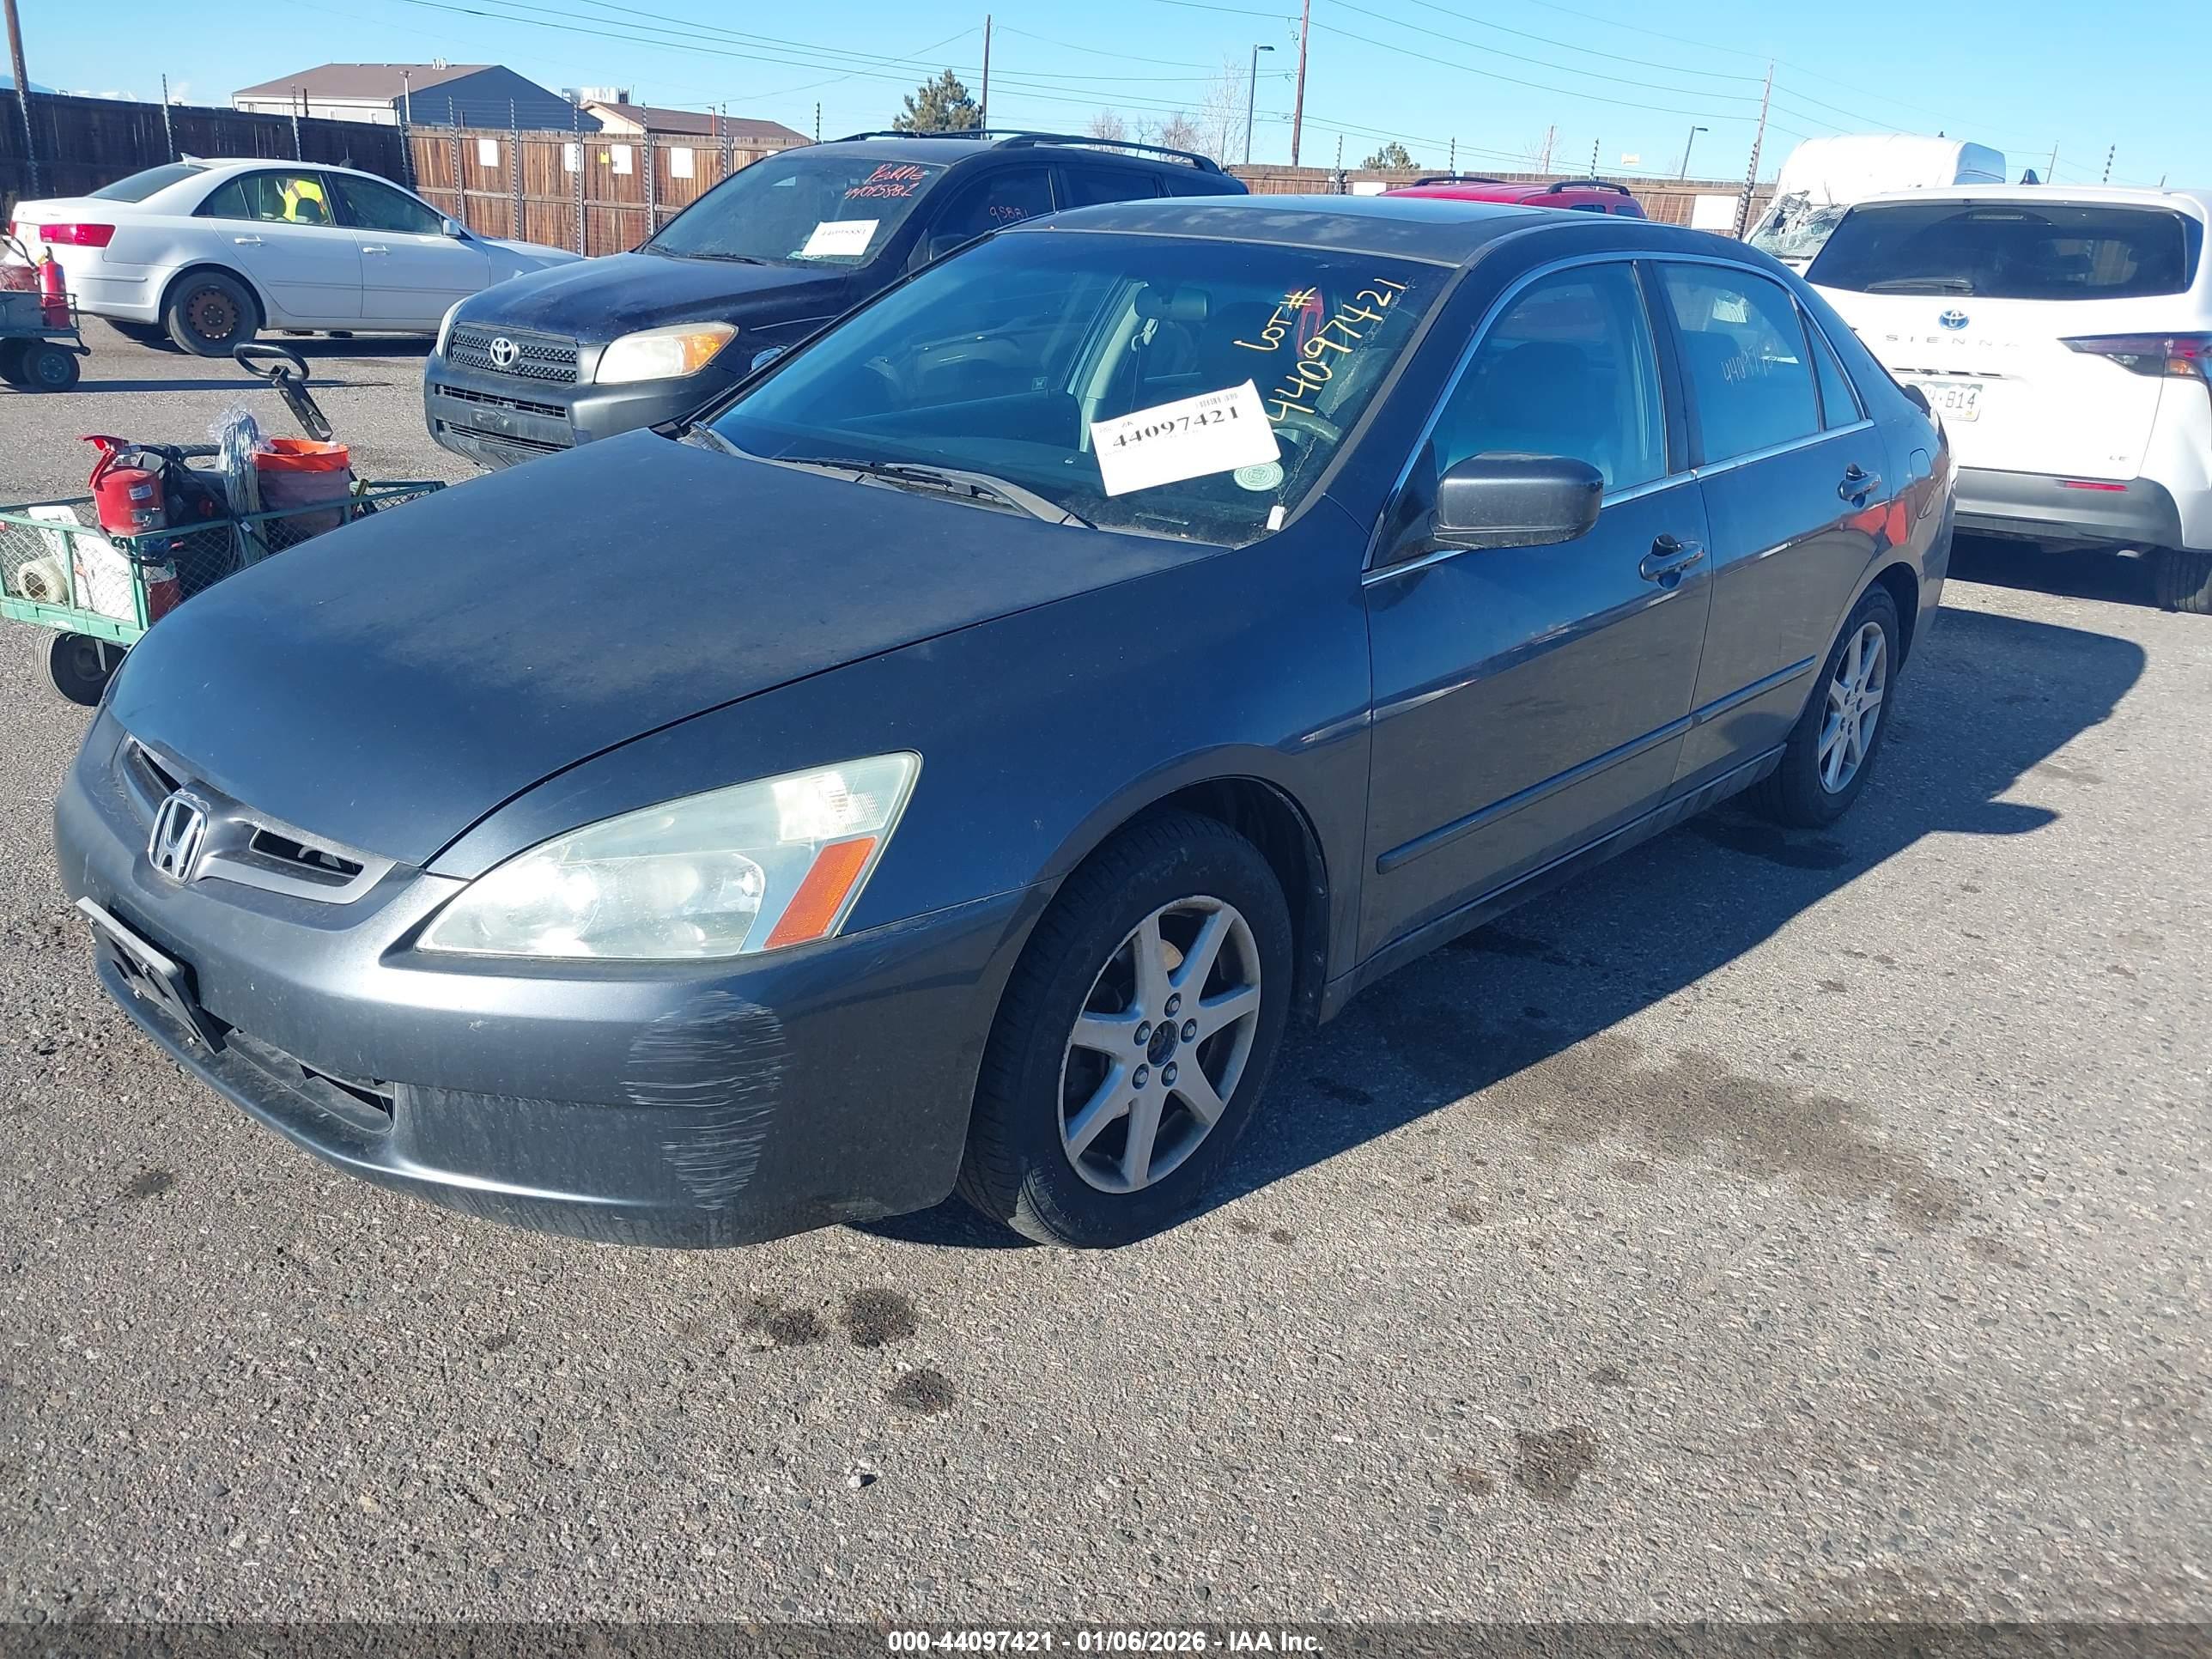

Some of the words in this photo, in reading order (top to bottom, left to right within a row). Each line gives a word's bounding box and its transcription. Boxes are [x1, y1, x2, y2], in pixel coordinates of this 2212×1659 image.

[1266, 278, 1407, 422] 44097421
[1886, 333, 2020, 348] SIENNA
[1113, 406, 1239, 447] 44097421
